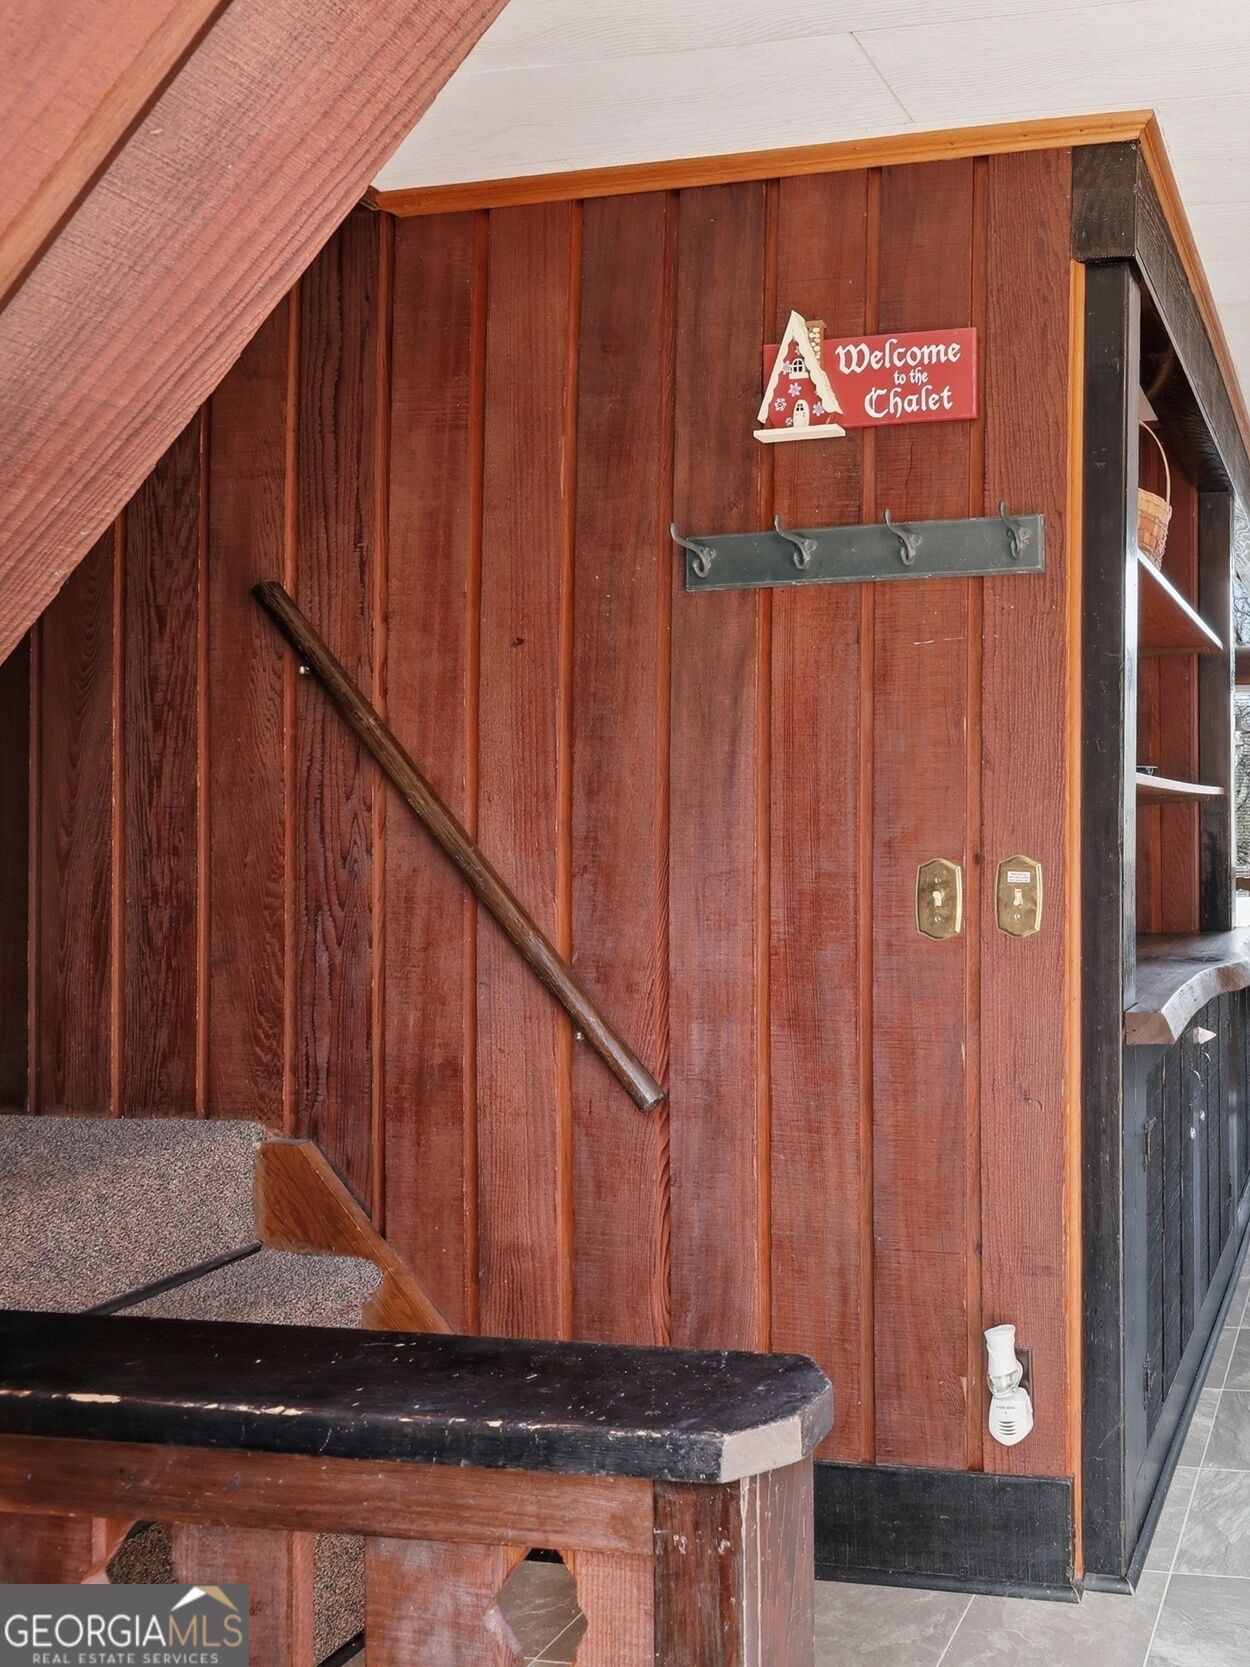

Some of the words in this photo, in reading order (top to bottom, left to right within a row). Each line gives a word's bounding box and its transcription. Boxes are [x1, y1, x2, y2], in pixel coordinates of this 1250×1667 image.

[835, 338, 961, 375] Welcome
[893, 370, 906, 385] to
[909, 367, 929, 385] the
[864, 385, 953, 418] Chalet
